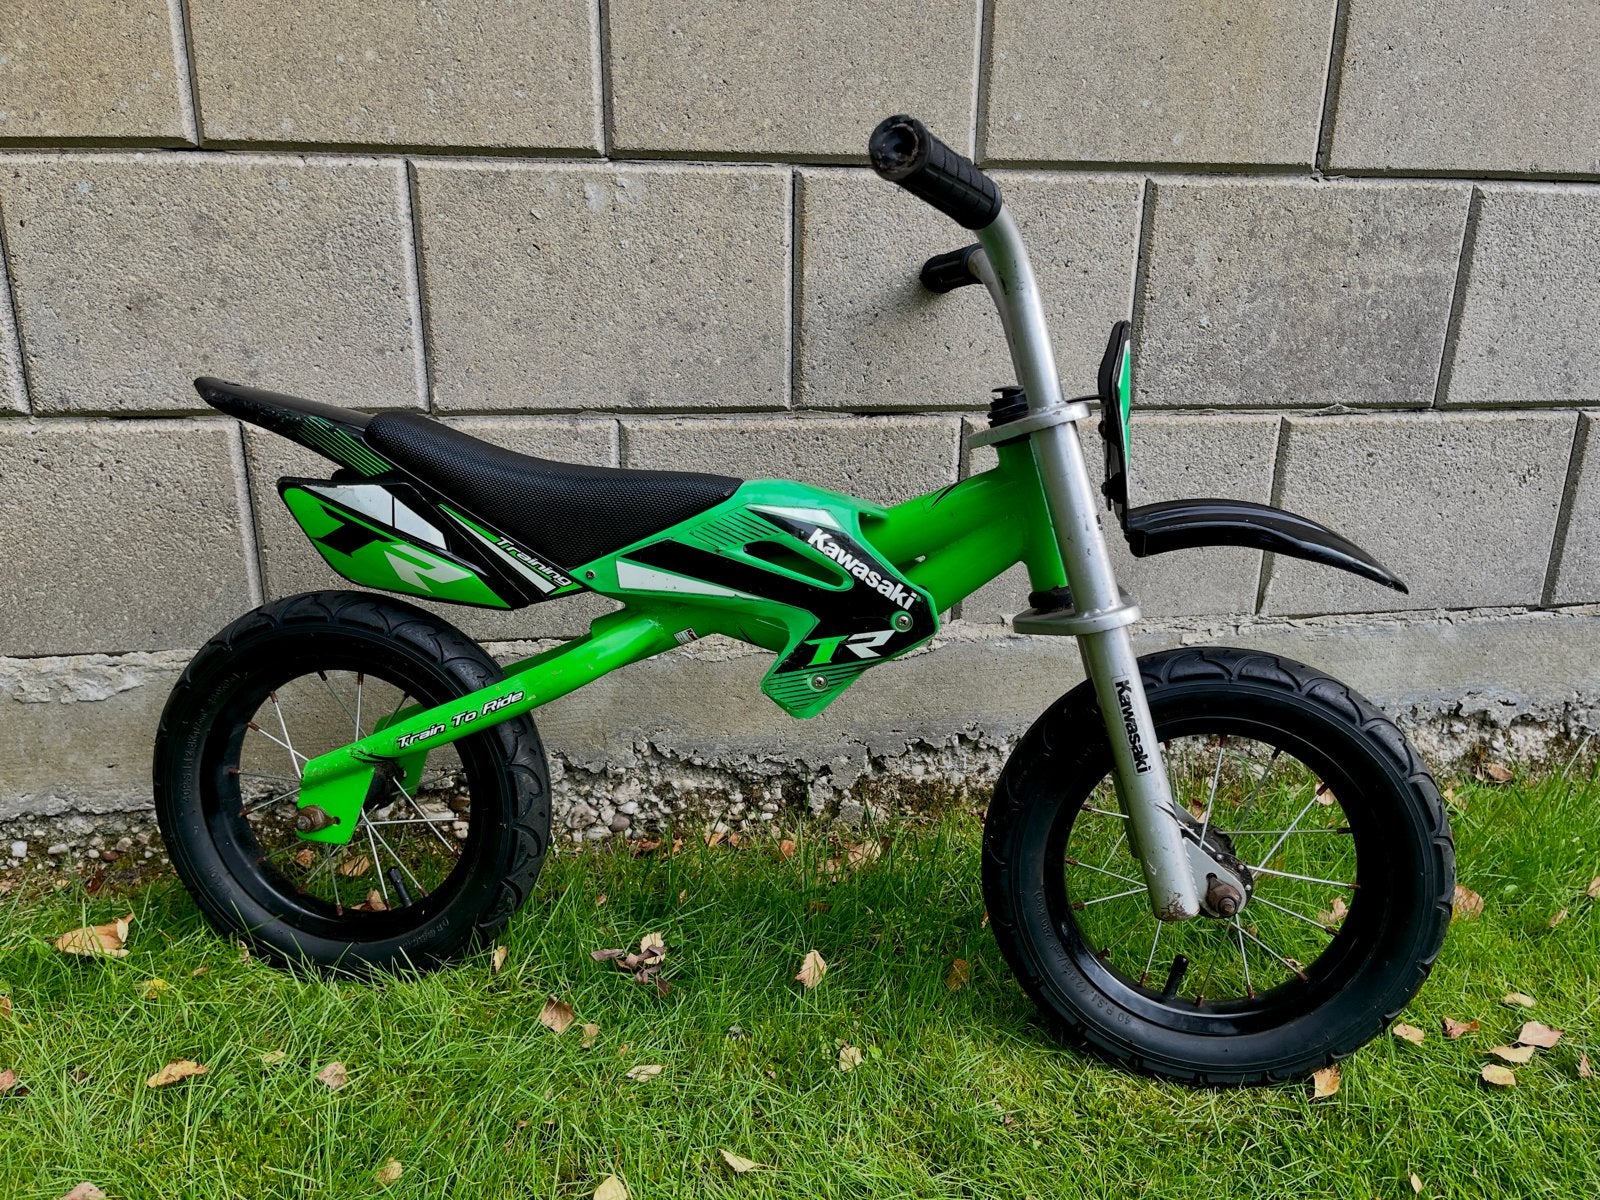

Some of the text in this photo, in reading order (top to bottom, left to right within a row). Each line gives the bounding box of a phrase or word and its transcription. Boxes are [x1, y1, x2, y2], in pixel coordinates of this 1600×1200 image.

[497, 536, 573, 587] Training
[807, 528, 917, 611] Kawasaki
[397, 690, 526, 750] Train To Ride
[1115, 679, 1152, 774] Kawasaki
